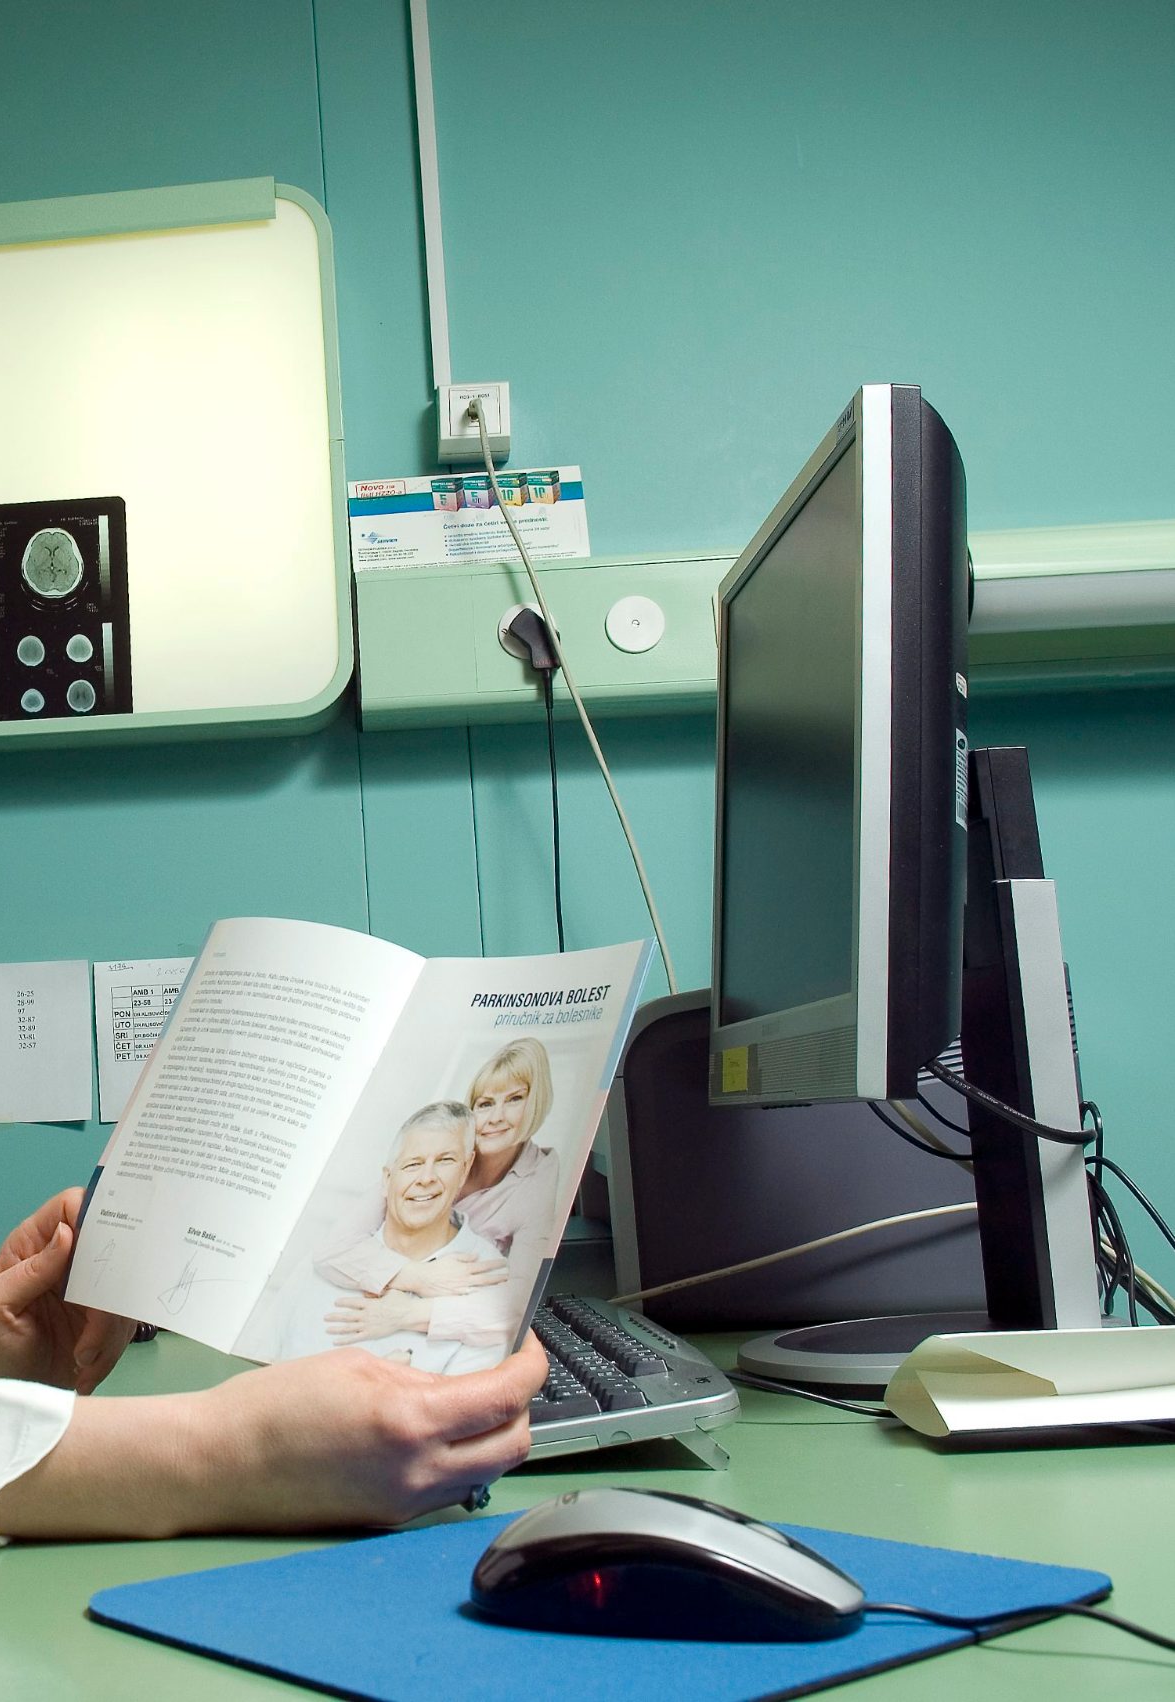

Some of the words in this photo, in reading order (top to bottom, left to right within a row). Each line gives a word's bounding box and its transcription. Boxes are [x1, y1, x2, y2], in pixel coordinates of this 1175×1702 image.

[471, 990, 564, 1008] PARKINSONOVA
[565, 984, 612, 1005] BOLEST
[494, 1010, 540, 1029] priručnik
[541, 1013, 554, 1025] za
[555, 1006, 603, 1024] bolesnike
[115, 1021, 131, 1029] UTO
[115, 1042, 131, 1050] ČET
[116, 1052, 131, 1060] PET
